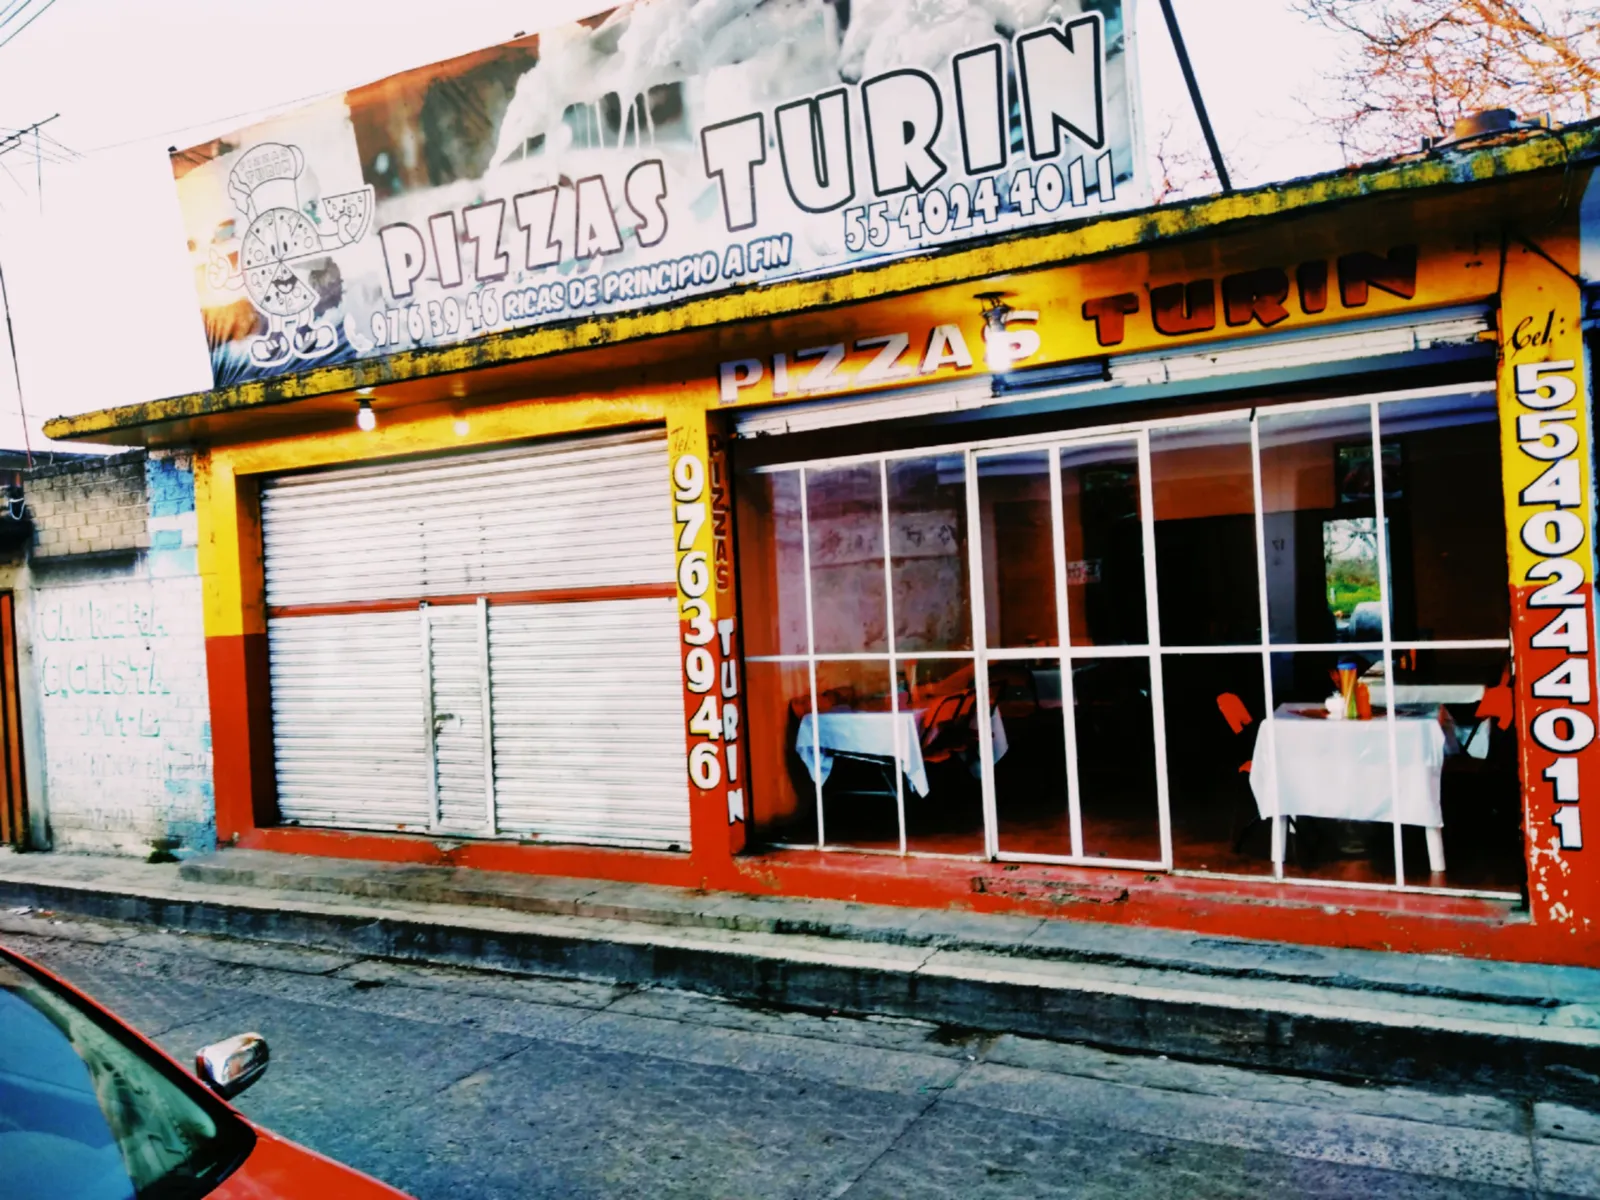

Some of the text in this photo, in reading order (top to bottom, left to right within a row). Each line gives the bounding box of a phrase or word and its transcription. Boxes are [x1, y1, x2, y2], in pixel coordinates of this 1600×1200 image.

[379, 15, 1104, 299] PIZZAS TURIN
[502, 233, 792, 321] RICAS DE PRINCIPIO A FIN
[717, 245, 1418, 404] PIZZAS TURIN
[717, 618, 745, 826] TURIN
